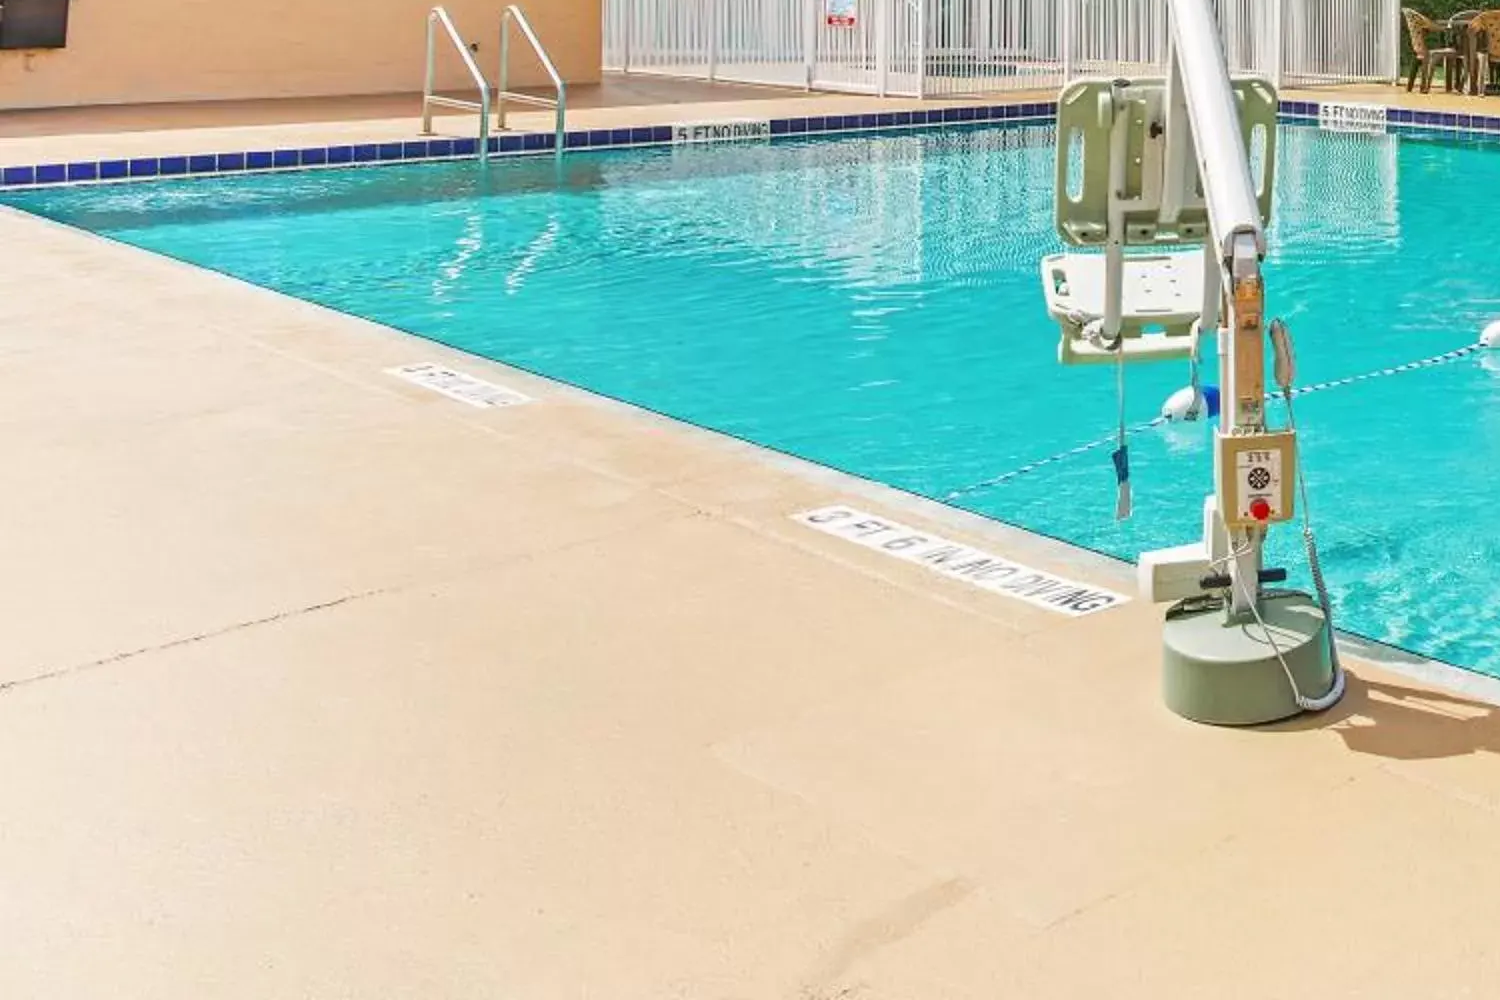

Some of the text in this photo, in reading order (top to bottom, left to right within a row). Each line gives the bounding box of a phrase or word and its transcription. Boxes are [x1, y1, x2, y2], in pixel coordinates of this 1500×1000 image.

[678, 121, 769, 140] 5 FT NO DIVING
[808, 511, 853, 523] 3
[839, 520, 892, 538] FT
[881, 535, 929, 550] 6
[950, 557, 1019, 581] NO
[1000, 573, 1116, 612] DIVING
